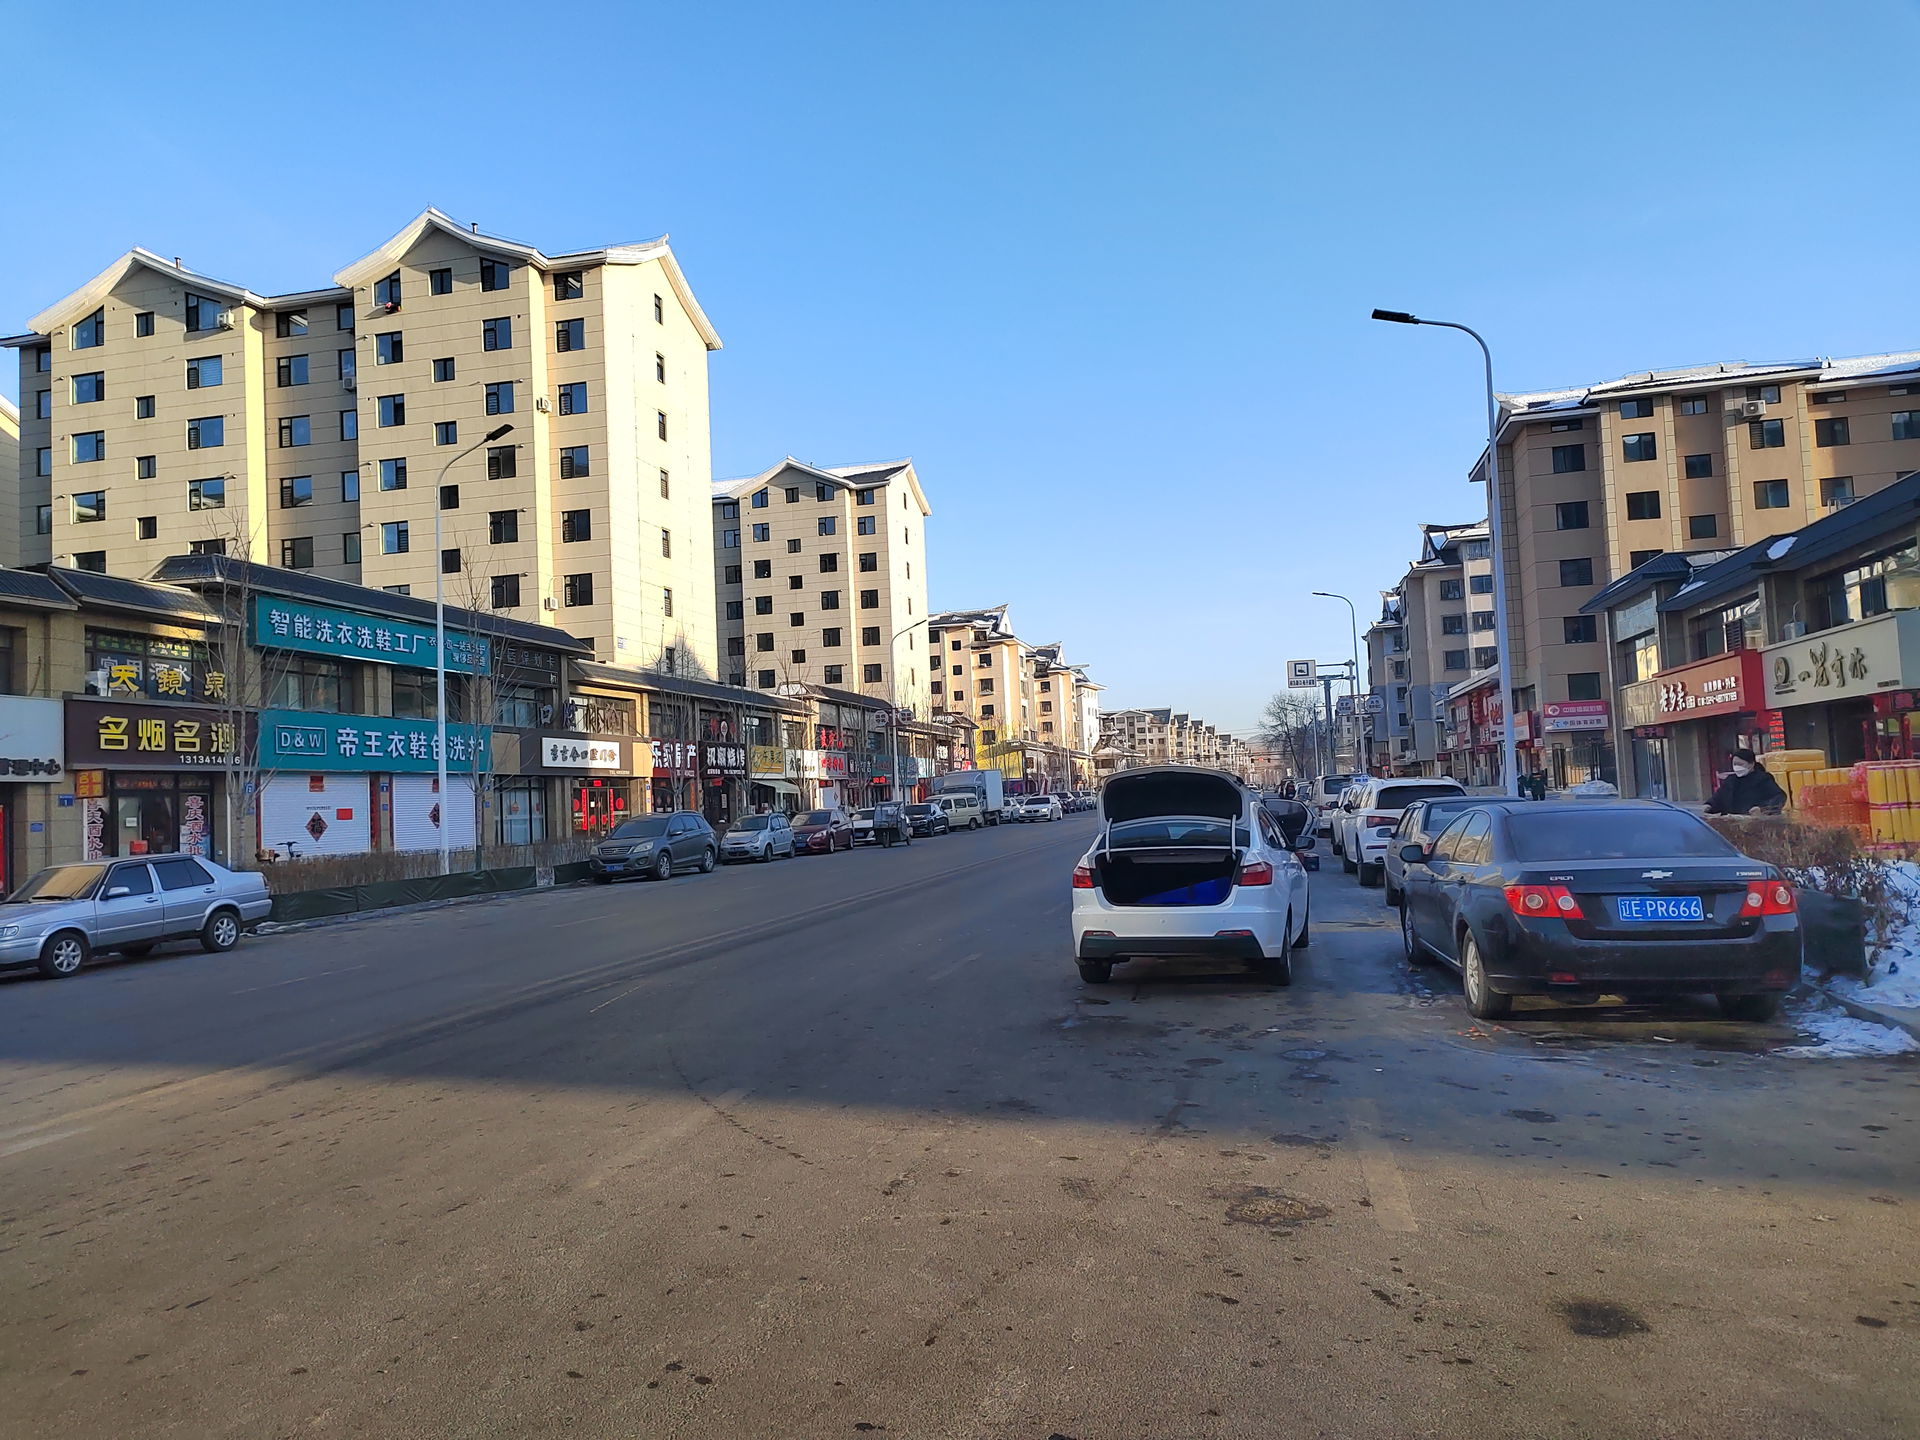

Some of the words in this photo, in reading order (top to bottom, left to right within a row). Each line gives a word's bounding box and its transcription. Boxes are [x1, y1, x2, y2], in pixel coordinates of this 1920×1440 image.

[269, 608, 426, 654] 智能洗衣洗鞋工厂
[98, 715, 236, 753] 名烟名酒
